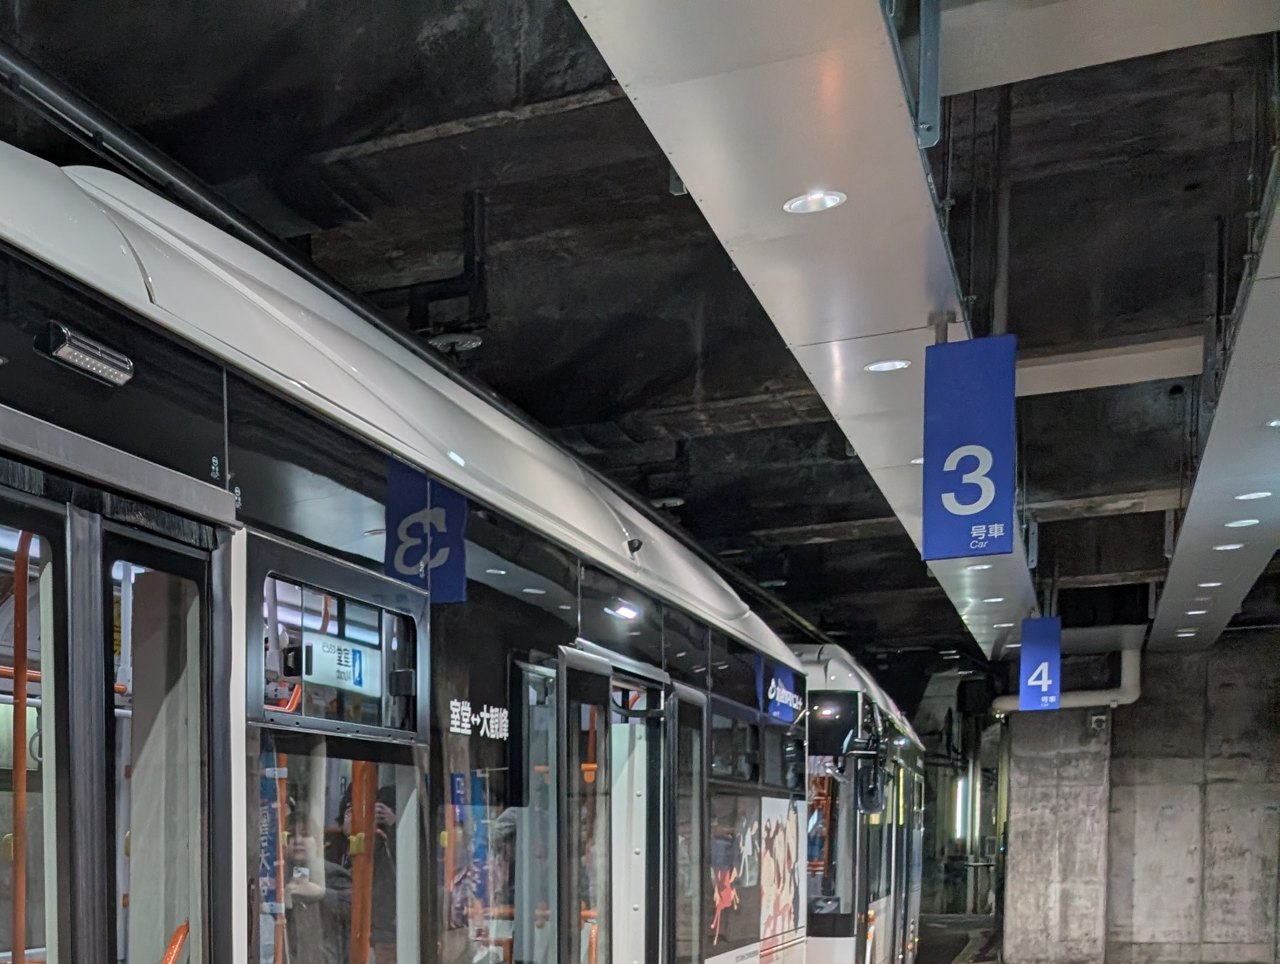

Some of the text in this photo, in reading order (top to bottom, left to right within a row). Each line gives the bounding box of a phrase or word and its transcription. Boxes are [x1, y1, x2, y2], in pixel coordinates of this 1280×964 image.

[941, 444, 996, 516] 3
[970, 523, 1006, 540] 号車
[969, 540, 988, 549] Car
[1027, 661, 1053, 692] 4
